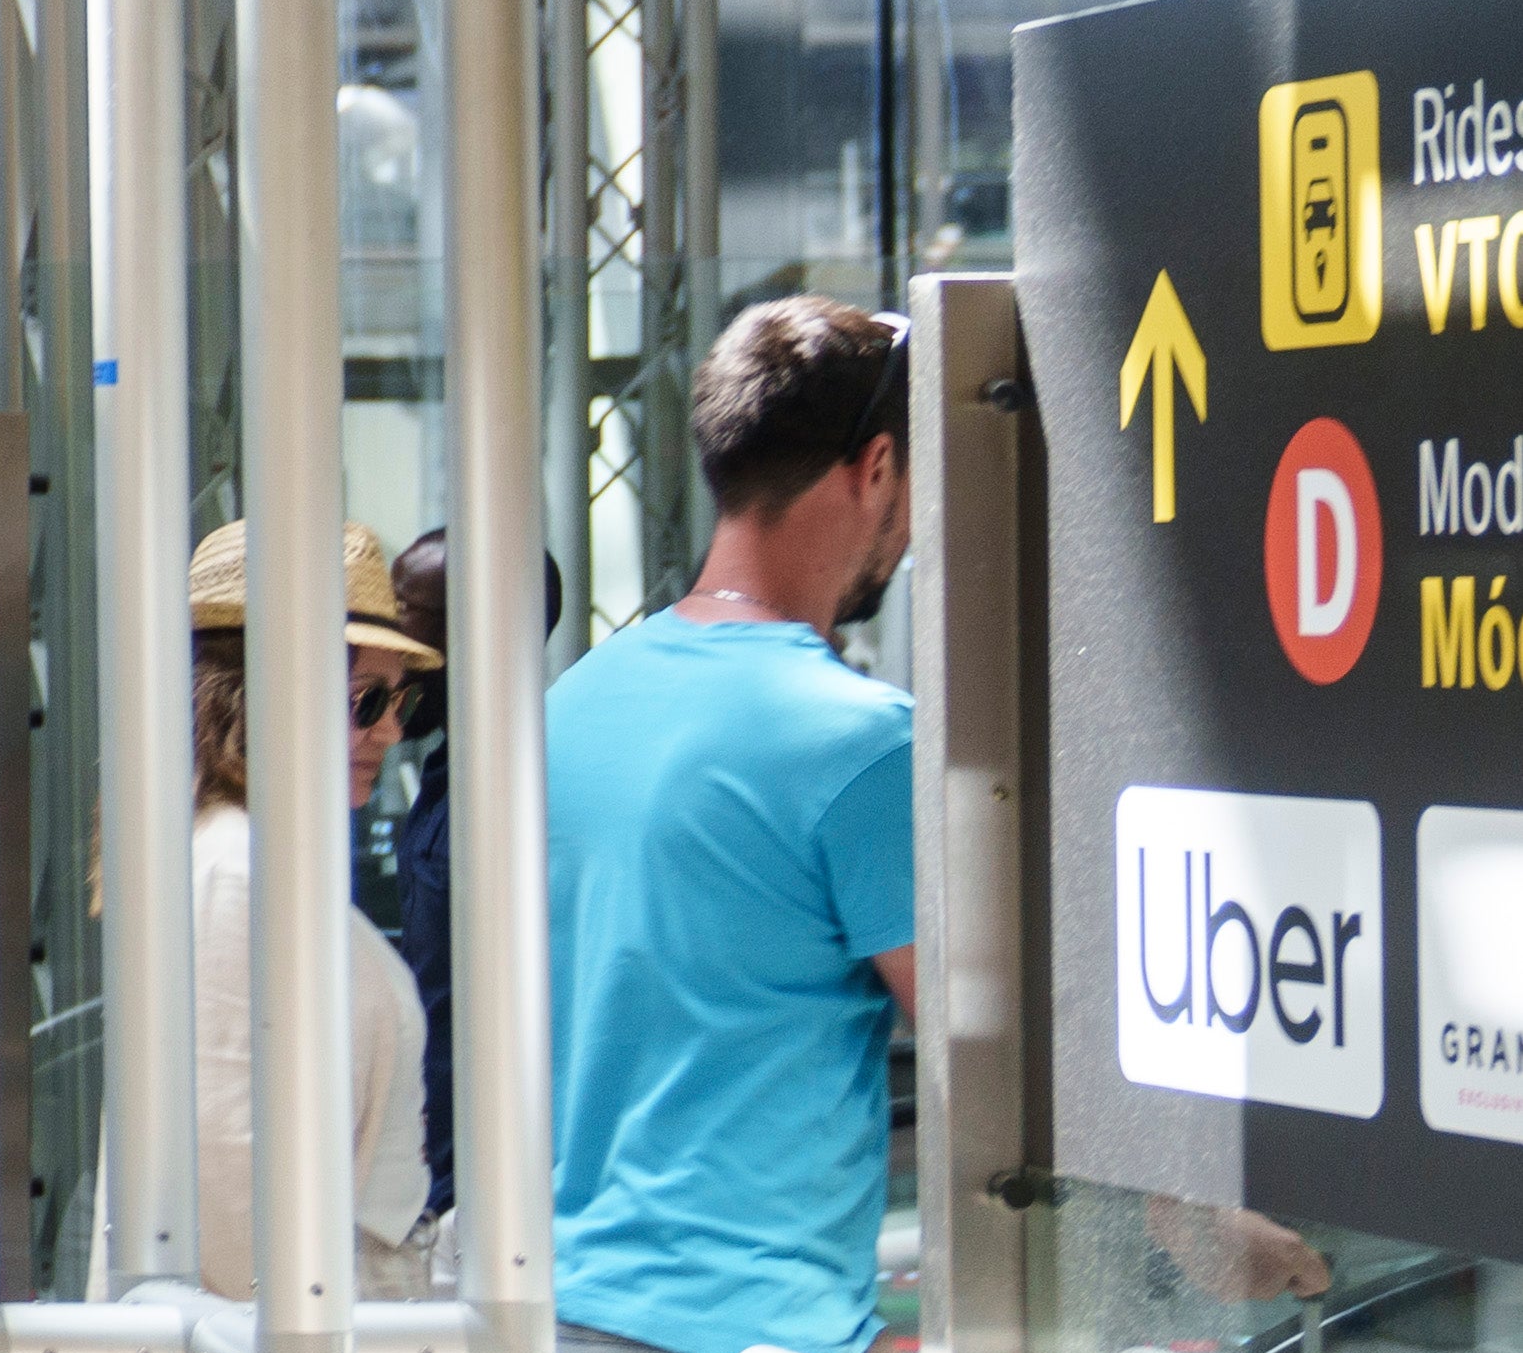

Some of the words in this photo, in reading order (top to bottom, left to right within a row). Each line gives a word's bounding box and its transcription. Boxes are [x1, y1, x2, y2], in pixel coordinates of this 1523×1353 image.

[1297, 469, 1359, 637] D
[1420, 575, 1523, 691] Mó
[1138, 847, 1363, 1049] Uber
